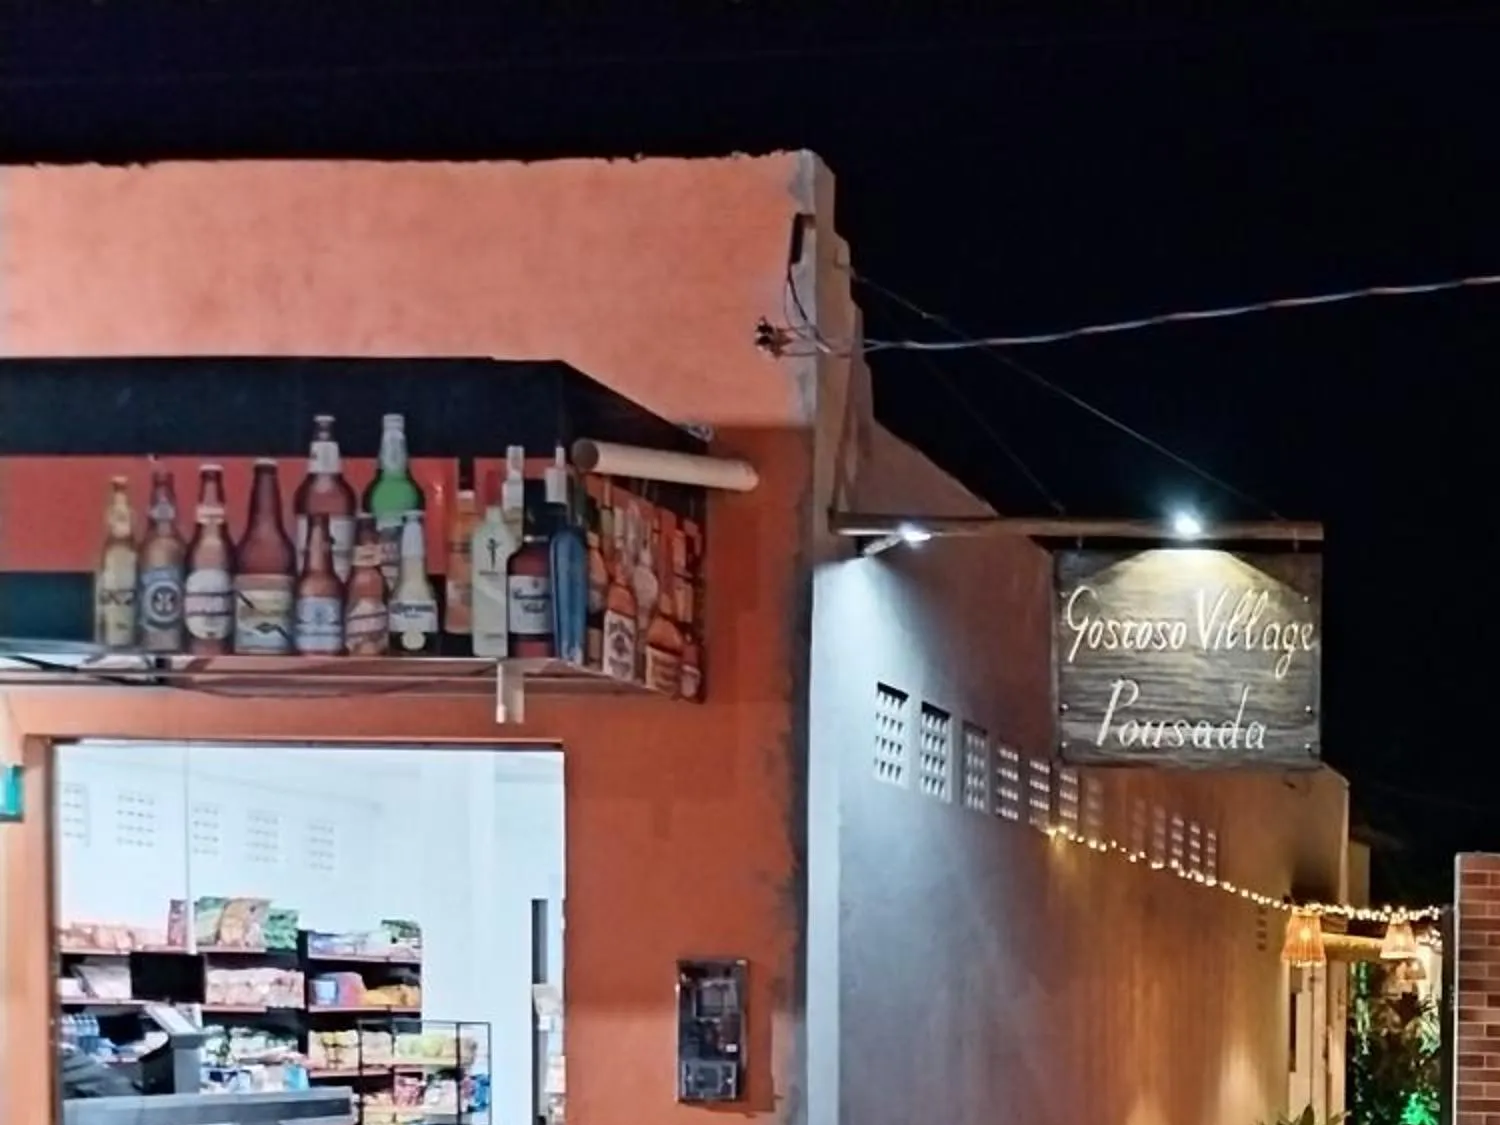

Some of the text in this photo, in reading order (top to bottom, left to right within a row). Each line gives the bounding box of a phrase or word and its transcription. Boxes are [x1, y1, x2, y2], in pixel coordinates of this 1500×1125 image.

[1066, 585, 1314, 680] Gostoso Village
[1095, 678, 1265, 750] Pousada
